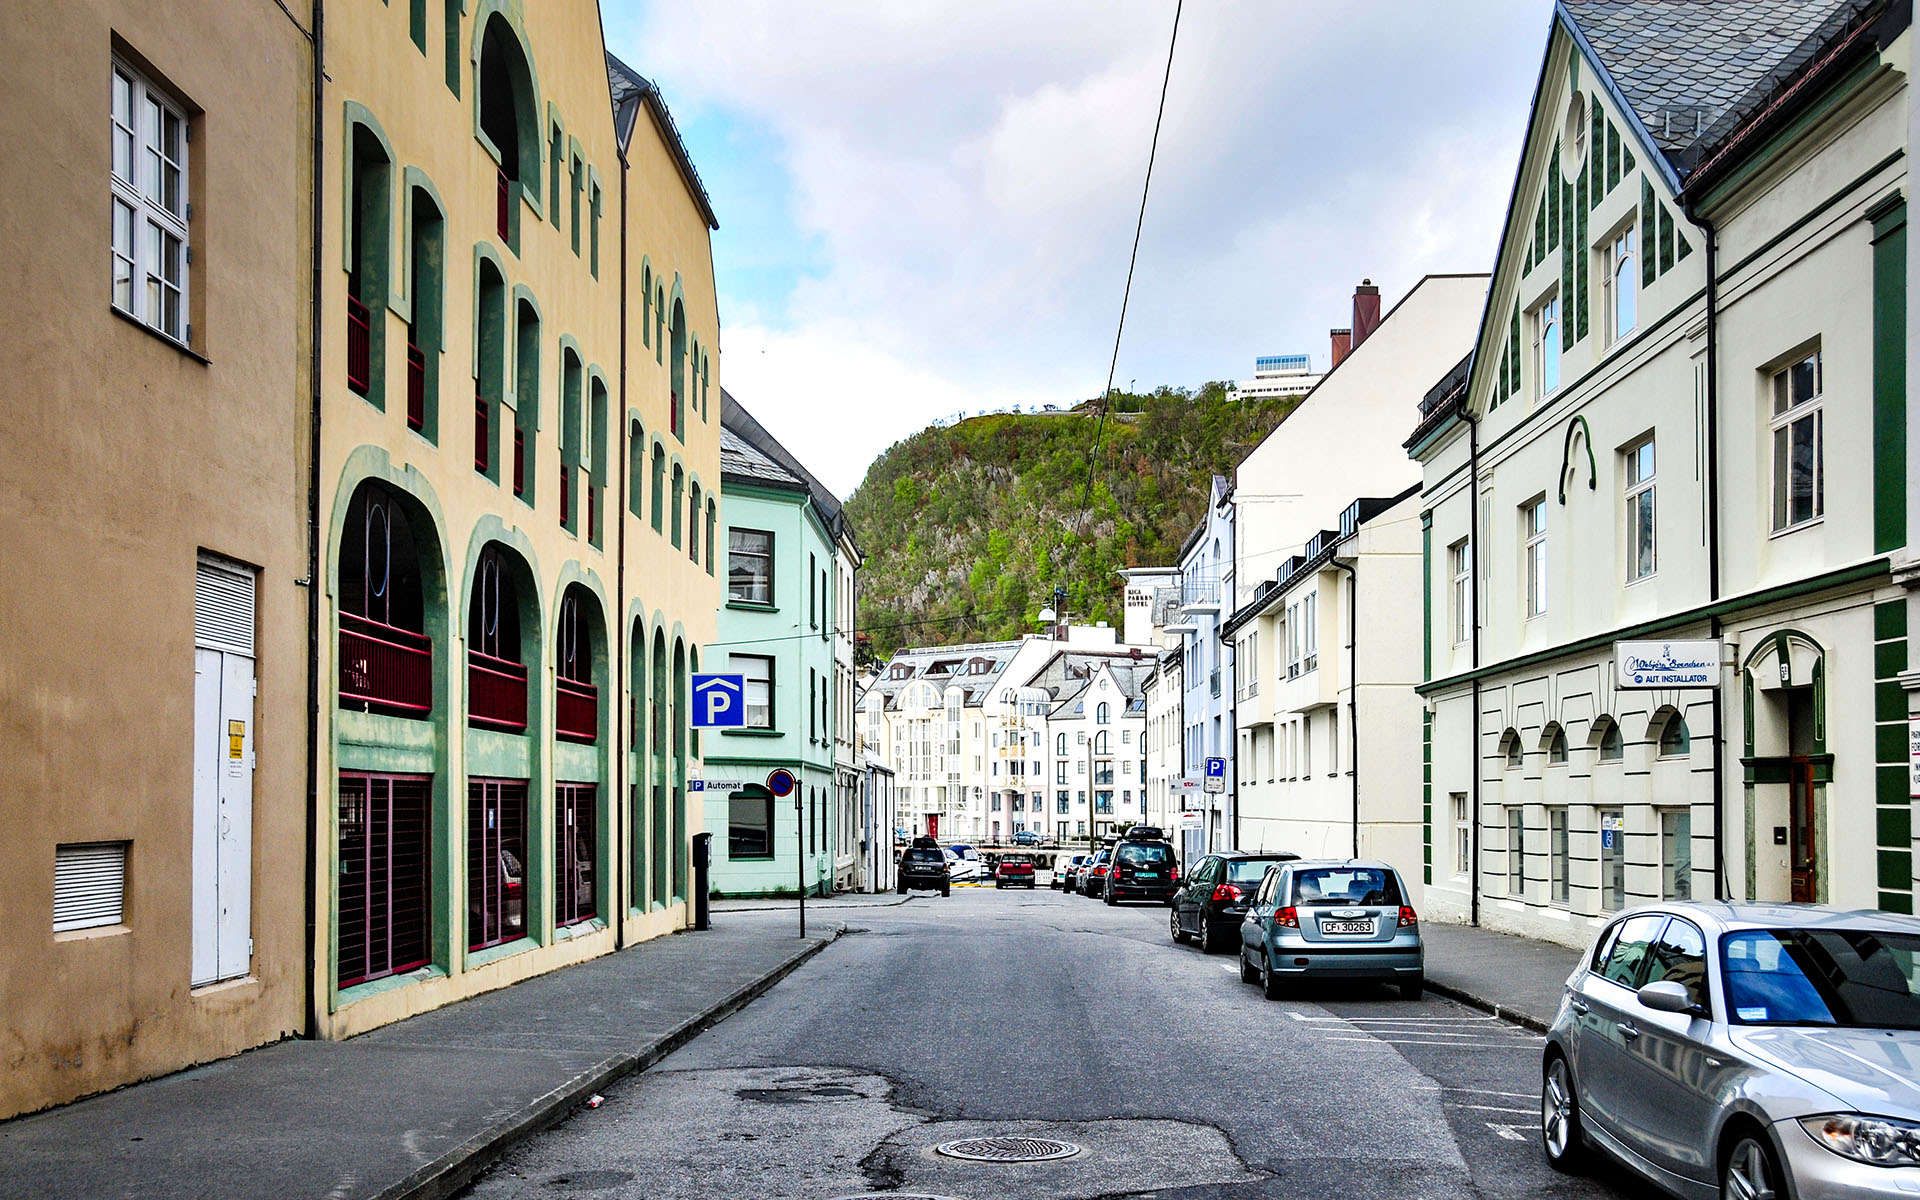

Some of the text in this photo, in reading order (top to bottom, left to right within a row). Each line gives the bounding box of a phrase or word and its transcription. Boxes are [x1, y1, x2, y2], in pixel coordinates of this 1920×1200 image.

[1646, 675, 1660, 683] AUT.
[1661, 675, 1707, 683] INSTALLATØR
[707, 691, 730, 724] P
[1211, 761, 1220, 774] P
[695, 782, 701, 790] P
[1325, 923, 1371, 931] CF 30263
